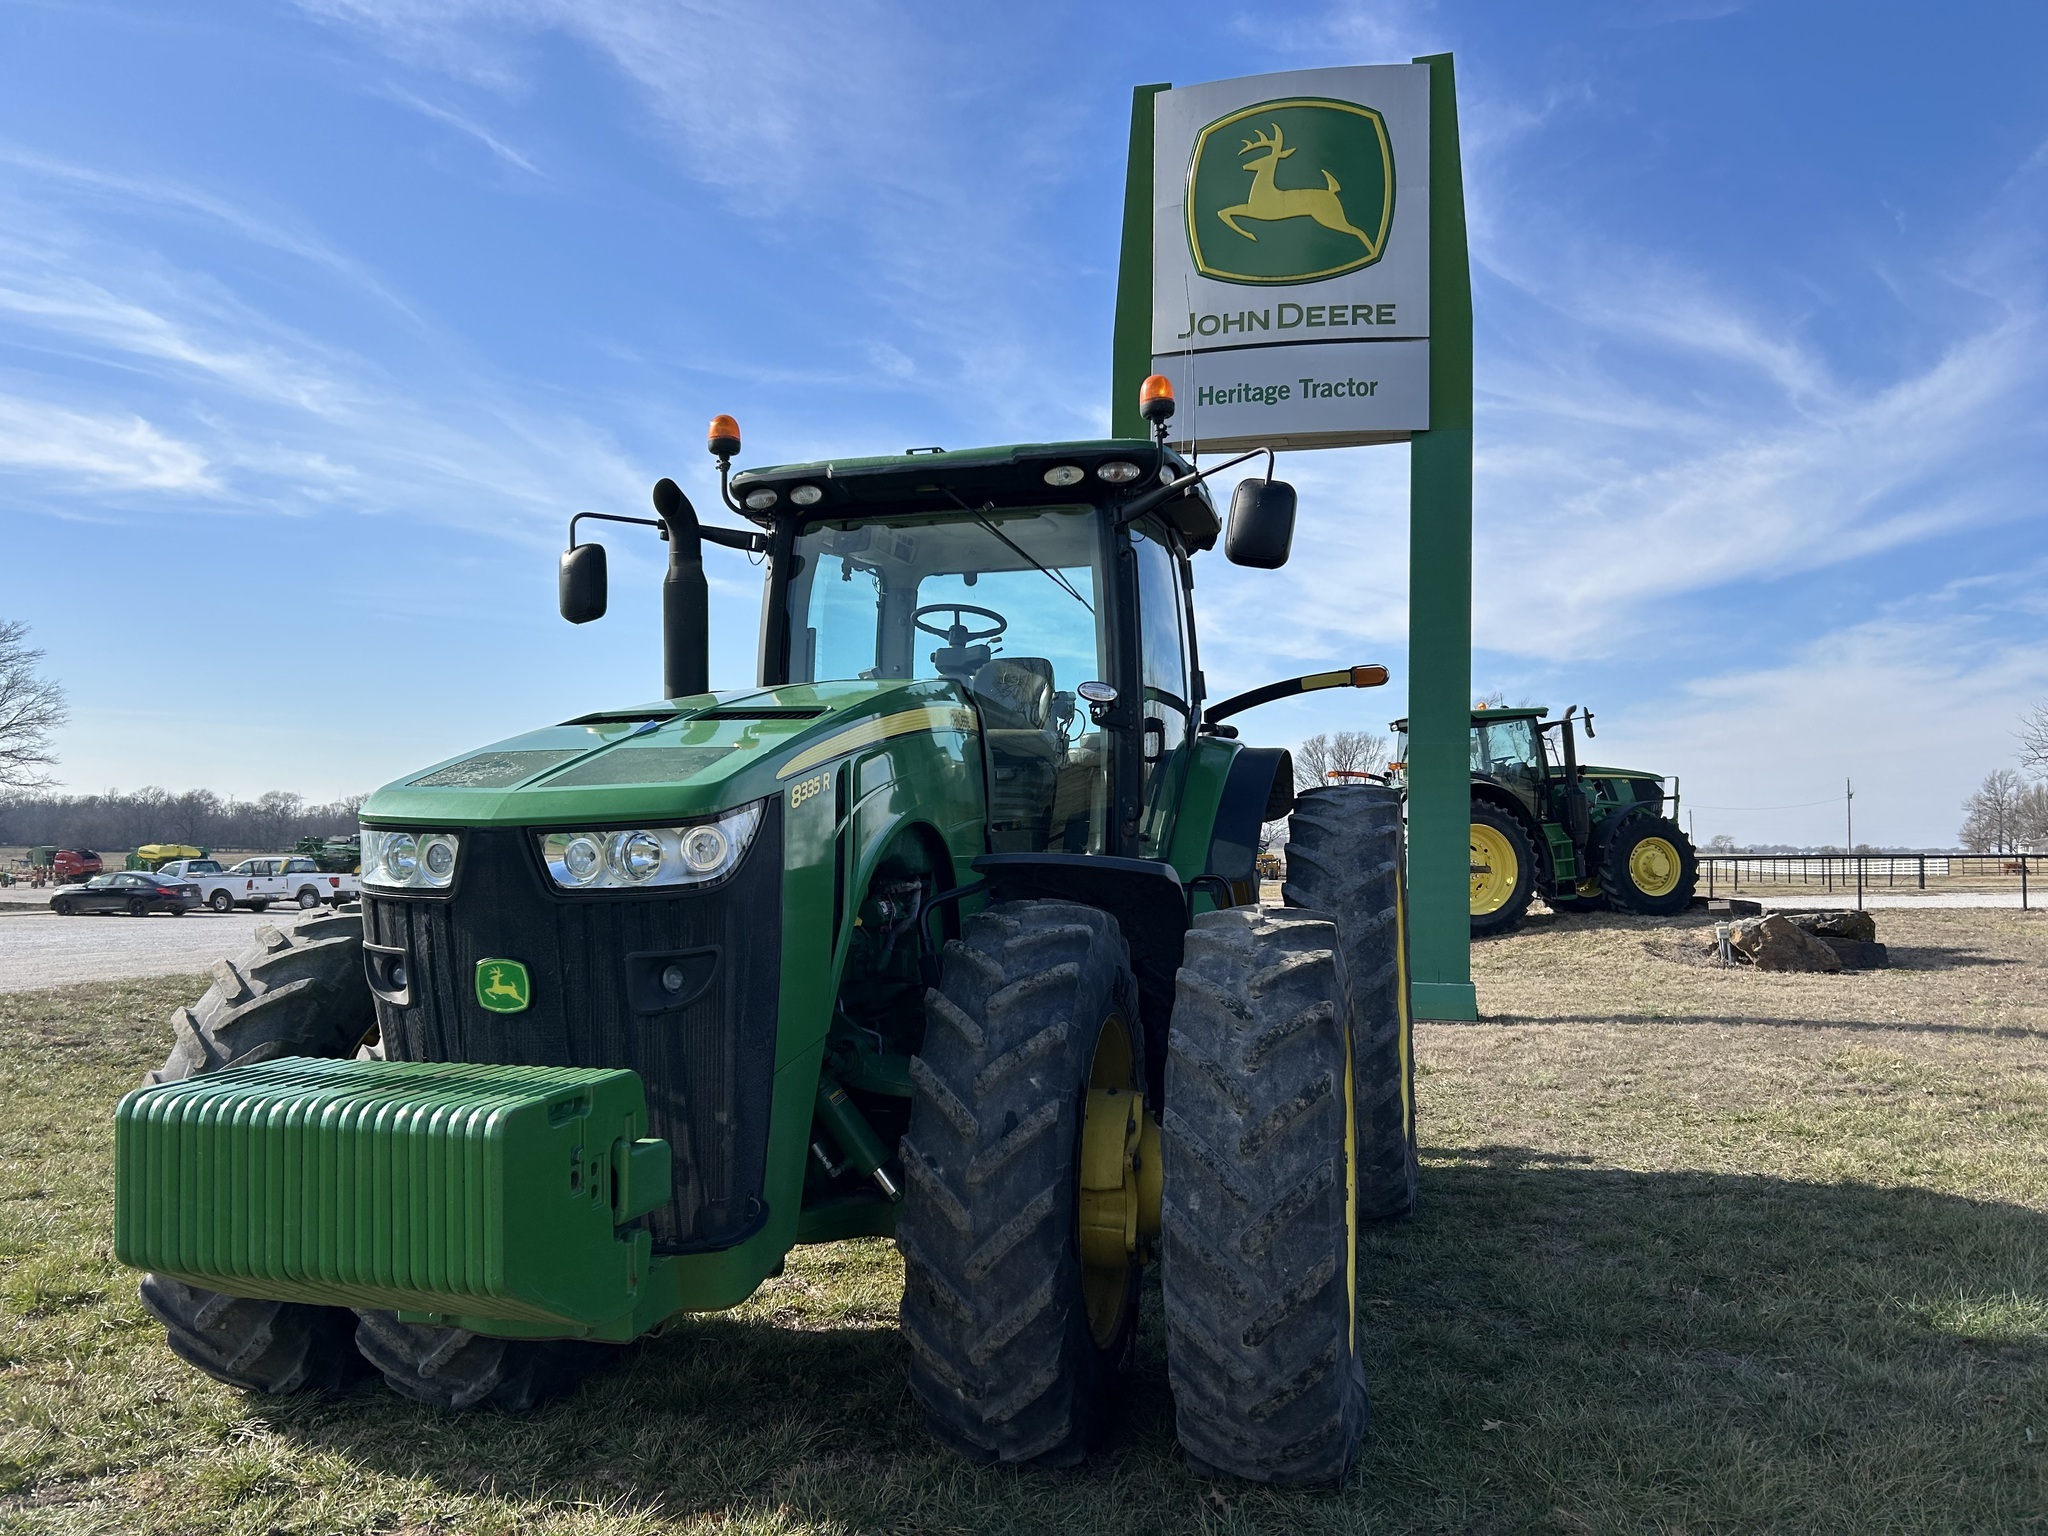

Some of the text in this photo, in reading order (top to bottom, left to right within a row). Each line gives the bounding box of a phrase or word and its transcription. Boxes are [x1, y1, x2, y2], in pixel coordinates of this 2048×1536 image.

[1178, 303, 1396, 339] JOHN DEERE
[1198, 378, 1378, 406] Heritage Tractor
[791, 771, 831, 809] 8335 R
